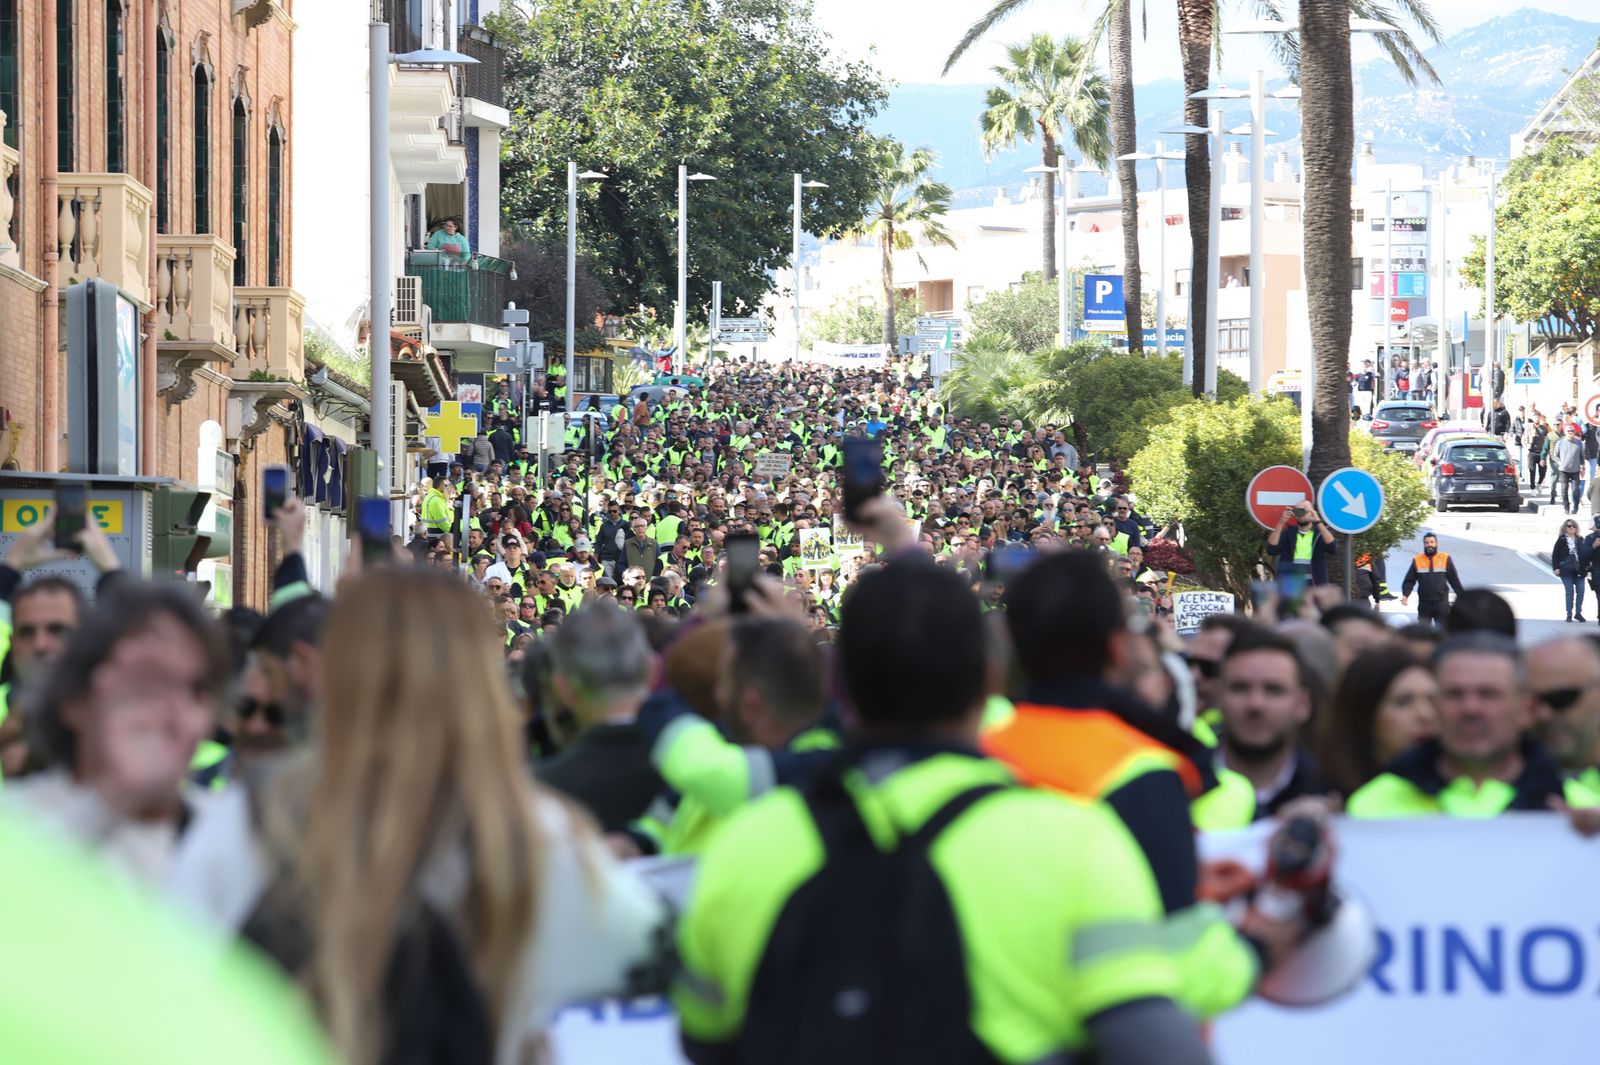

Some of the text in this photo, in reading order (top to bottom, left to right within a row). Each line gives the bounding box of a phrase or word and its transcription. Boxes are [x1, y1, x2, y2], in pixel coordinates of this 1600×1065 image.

[1095, 280, 1113, 304] P
[1108, 332, 1129, 341] Plaz
[17, 505, 110, 528] OE
[1178, 593, 1232, 604] ACERINOX
[1182, 604, 1226, 612] ESCUCHA
[1368, 926, 1600, 995] RINO
